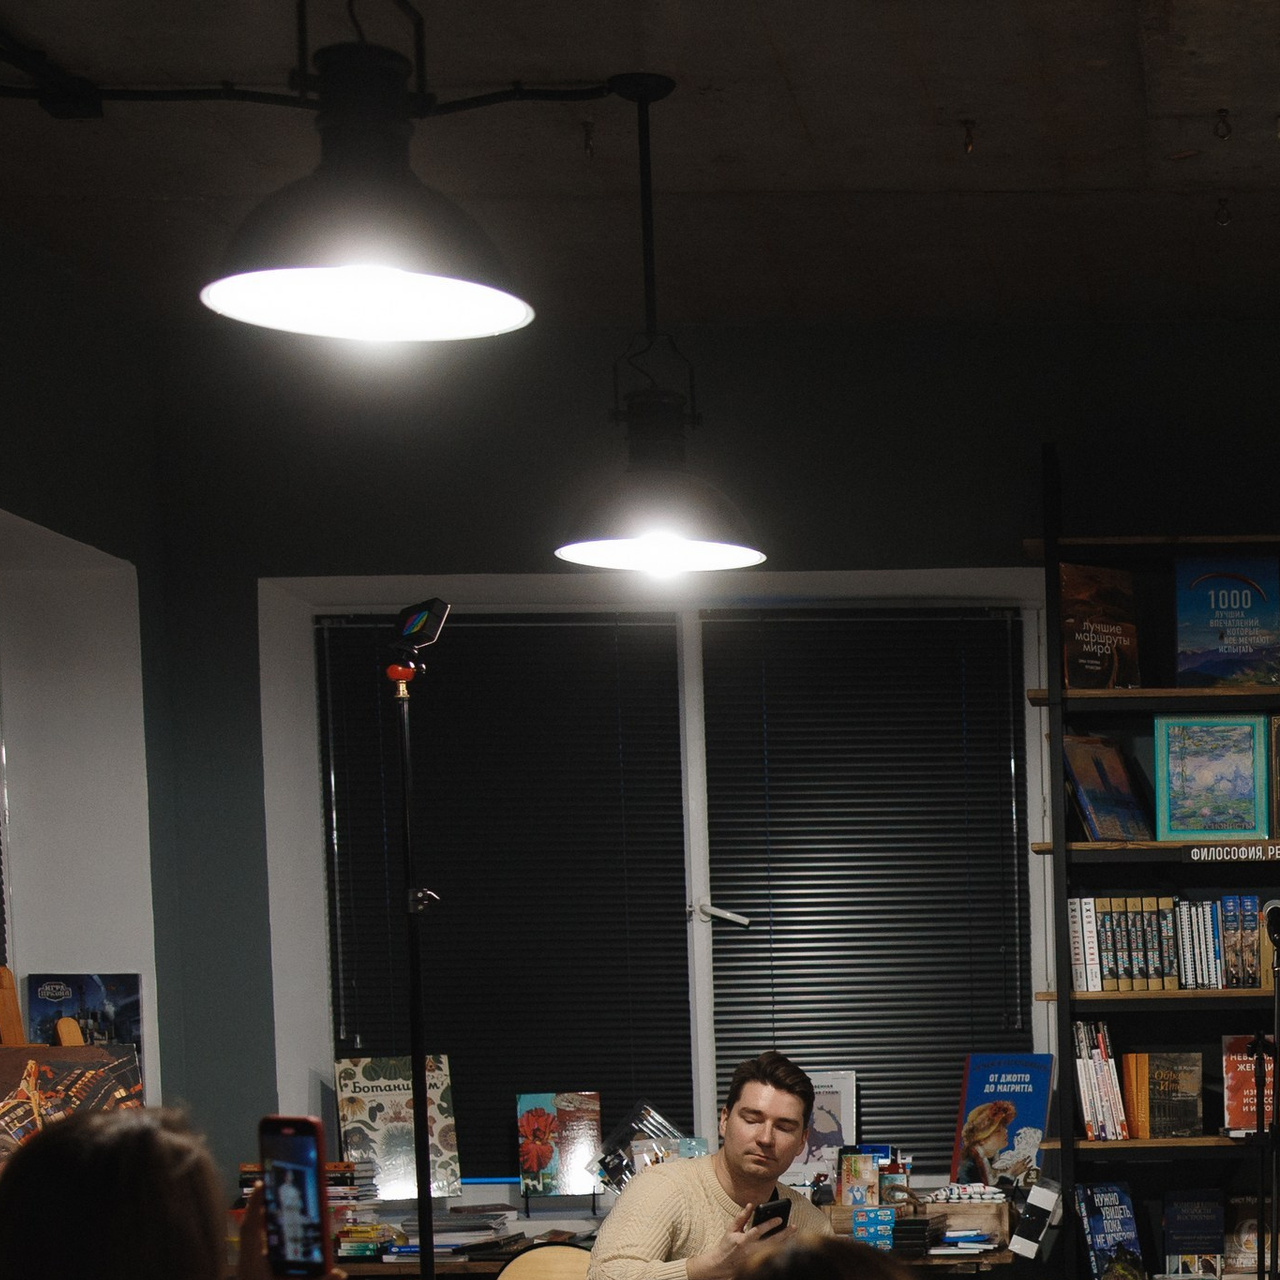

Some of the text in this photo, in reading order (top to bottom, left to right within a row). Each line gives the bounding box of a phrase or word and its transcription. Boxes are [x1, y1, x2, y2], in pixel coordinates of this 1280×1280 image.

[1208, 590, 1251, 609] 1000
[1083, 622, 1122, 635] лучшие
[1209, 617, 1259, 627] ВПЕЧАТЛЕНИЙ
[1075, 632, 1130, 647] маршруты
[1239, 636, 1269, 644] МЕЧТАЮТ
[1083, 644, 1111, 656] мира
[1191, 847, 1266, 861] ФИЛОСОФИЯ,
[989, 1073, 1030, 1083] ОТ ДЖОТТО
[351, 1081, 441, 1094] Ботаним
[983, 1084, 1033, 1093] ДО МАГРИТТА
[1093, 1193, 1119, 1207] НУЖНО
[1103, 1219, 1123, 1233] ПОКА
[1096, 1233, 1106, 1247] НЕ
